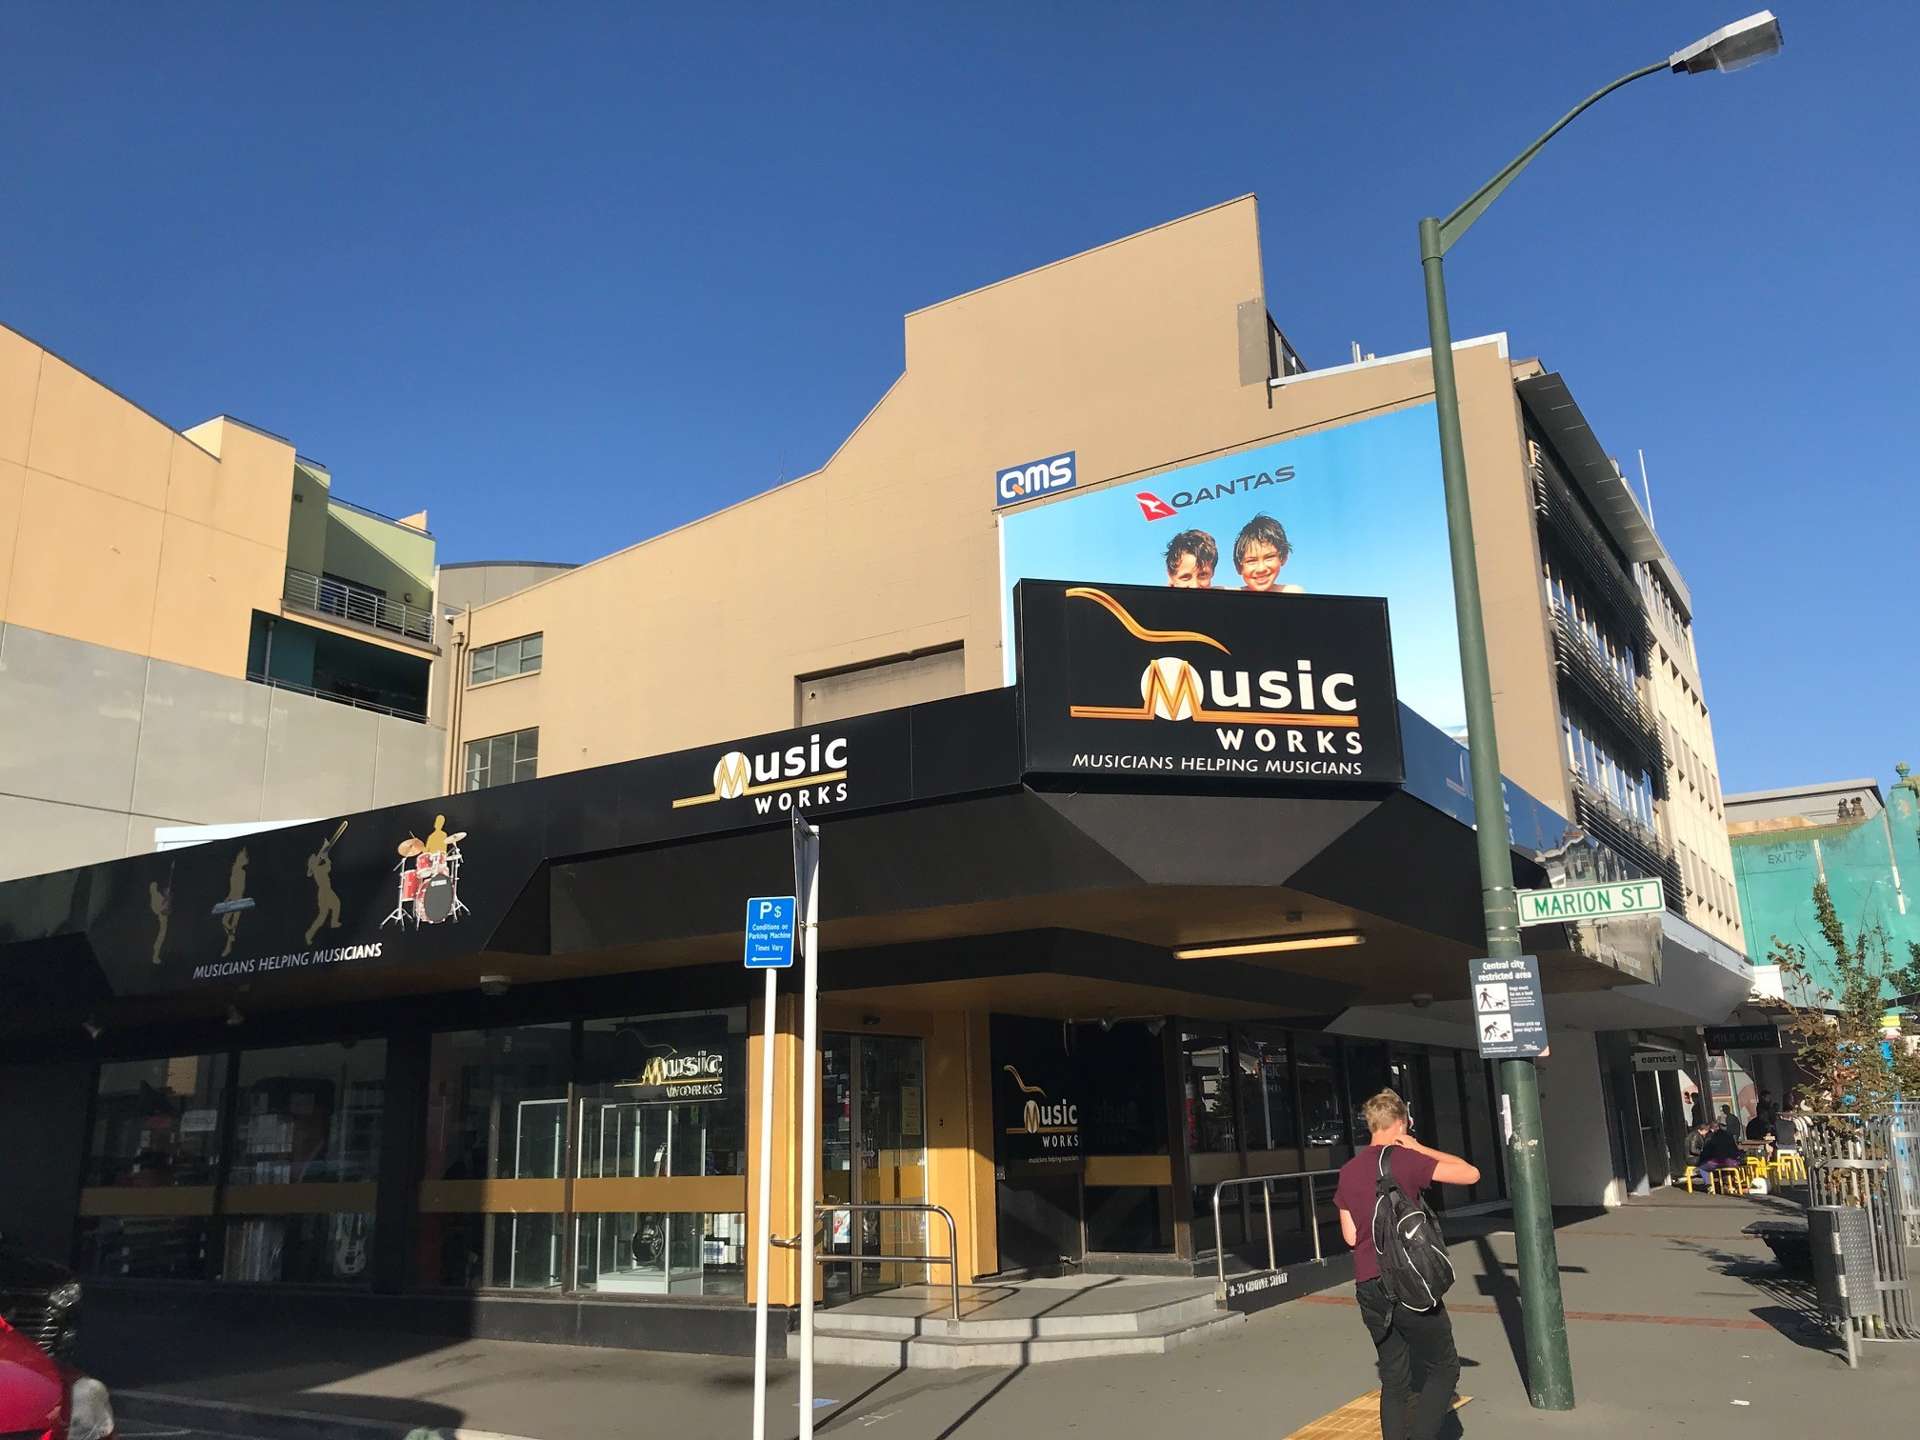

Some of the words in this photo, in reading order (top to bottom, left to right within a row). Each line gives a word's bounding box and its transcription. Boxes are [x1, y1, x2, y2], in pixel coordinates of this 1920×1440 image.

[1000, 457, 1072, 499] QMS
[1171, 465, 1296, 509] QANTAS
[1140, 657, 1359, 722] Music
[1216, 727, 1363, 755] WORKS
[713, 733, 848, 800] Music
[1072, 754, 1174, 770] MUSICIANS
[1181, 757, 1259, 773] HELPING
[1265, 759, 1363, 776] MUSICIANS
[755, 782, 848, 815] WORKS
[760, 901, 772, 920] P
[1534, 889, 1611, 917] MARION
[1621, 886, 1644, 908] ST
[749, 932, 768, 940] Parking
[752, 923, 780, 931] Conditions
[193, 958, 255, 980] MUSICIANS
[258, 952, 310, 971] HELPING
[312, 942, 382, 964] MUSICIANS
[755, 944, 770, 952] Times
[771, 944, 784, 953] Vary
[1478, 971, 1513, 981] restricted
[1515, 971, 1532, 979] area
[1482, 960, 1509, 970] Central
[1510, 959, 1525, 969] city
[1023, 1098, 1078, 1134] Music
[1042, 1134, 1079, 1148] WORKS
